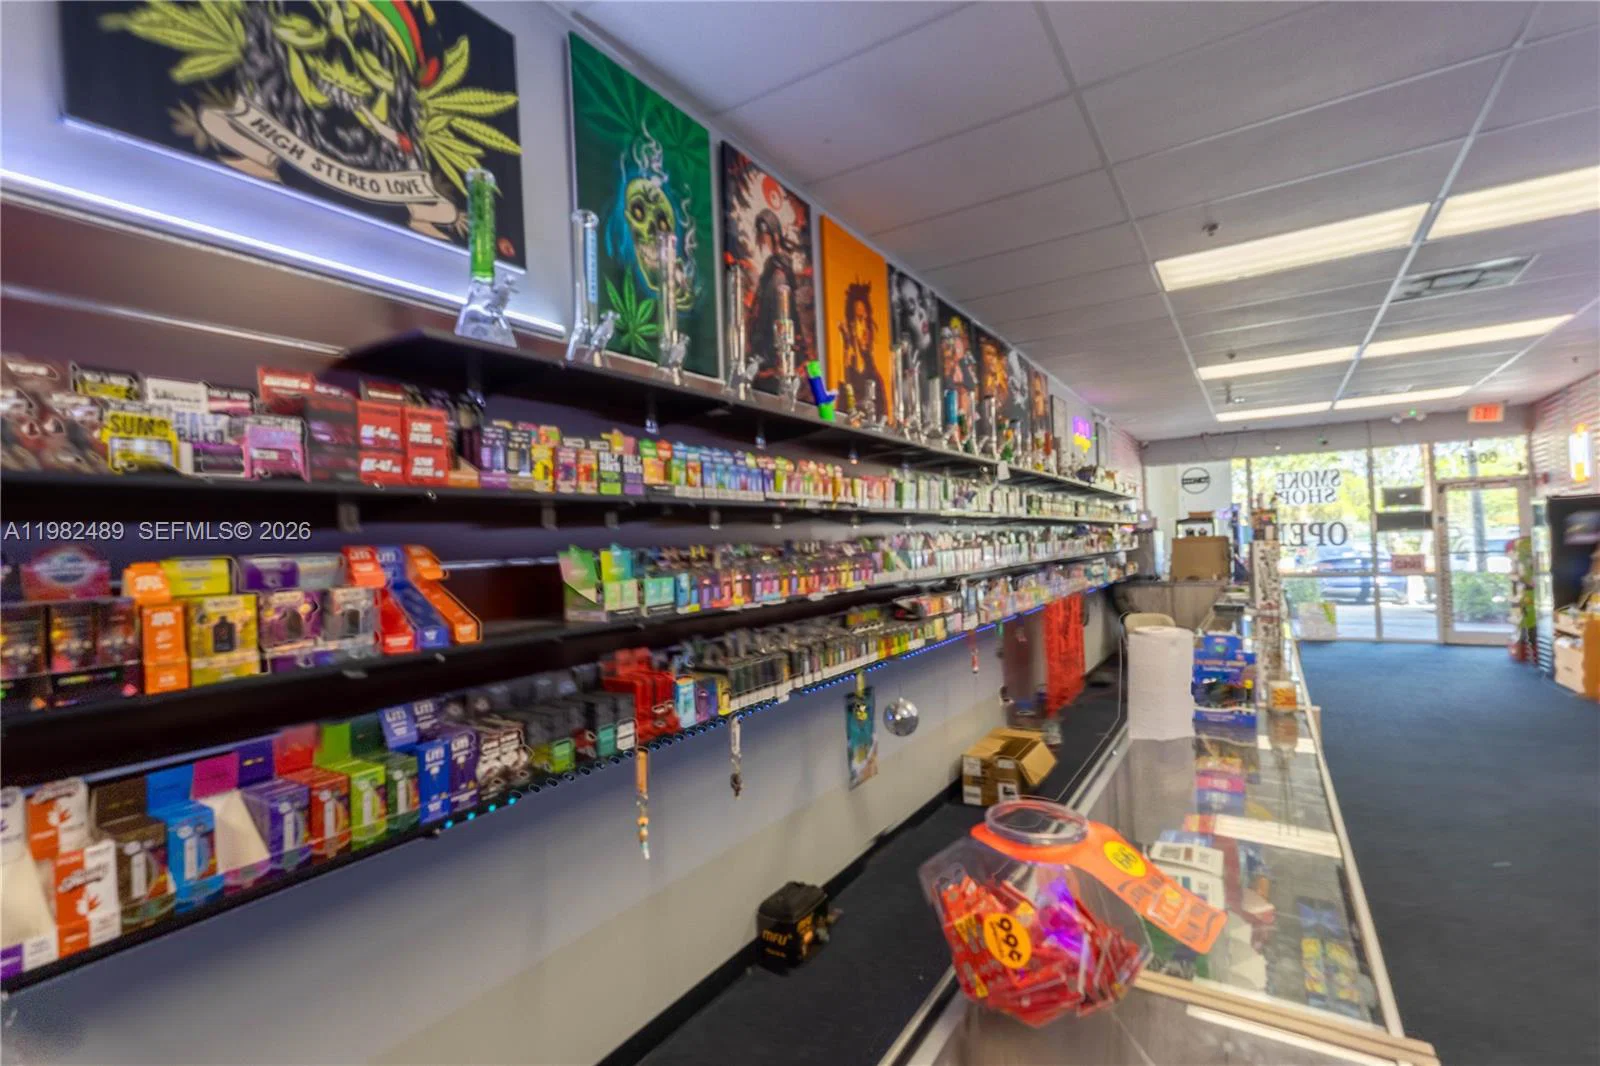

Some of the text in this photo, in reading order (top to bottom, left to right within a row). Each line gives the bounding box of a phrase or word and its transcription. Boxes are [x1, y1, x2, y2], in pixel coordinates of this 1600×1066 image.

[250, 117, 423, 196] HIGH STEREO LOVE
